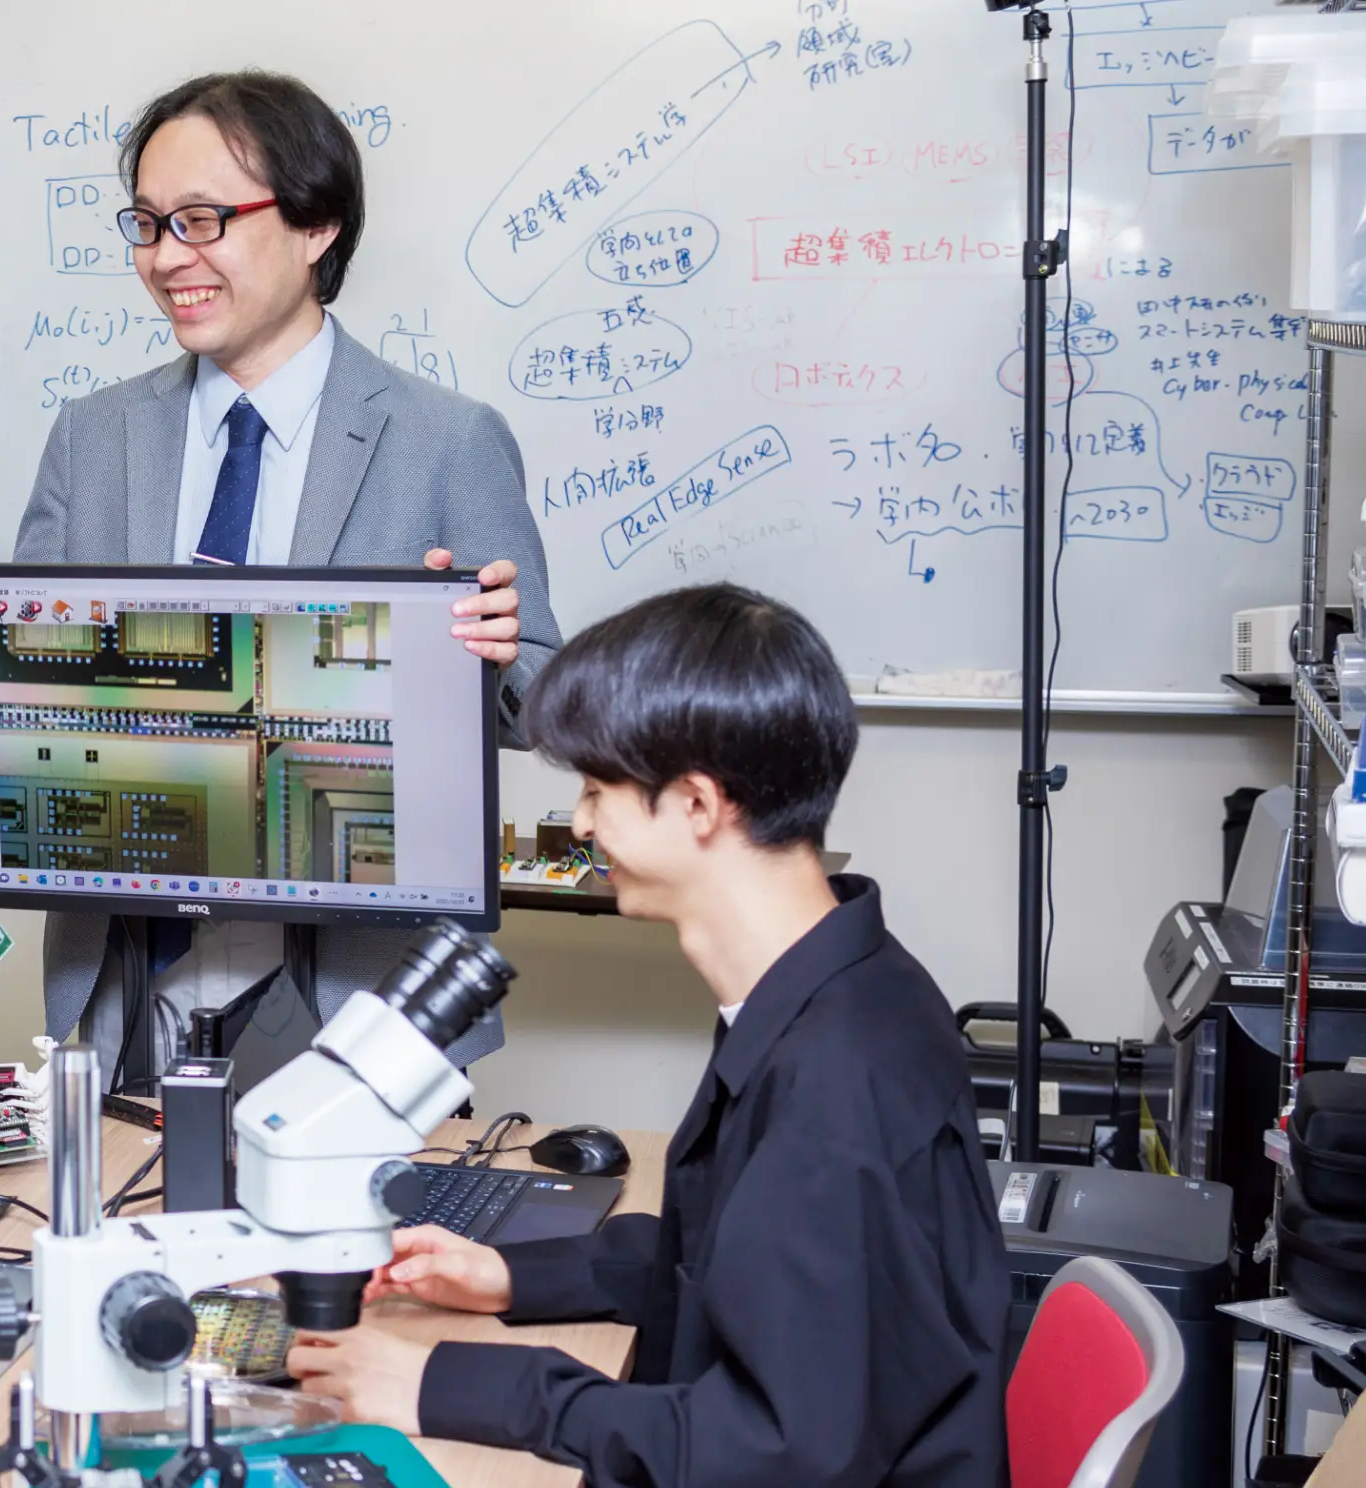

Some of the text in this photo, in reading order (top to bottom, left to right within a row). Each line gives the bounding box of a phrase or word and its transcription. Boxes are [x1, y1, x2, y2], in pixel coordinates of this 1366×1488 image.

[796, 17, 862, 58] 領域
[12, 104, 133, 151] Tactile
[773, 360, 906, 394] ロボティクス
[620, 437, 781, 546] Real Edge Sense
[178, 903, 211, 915] BenQ
